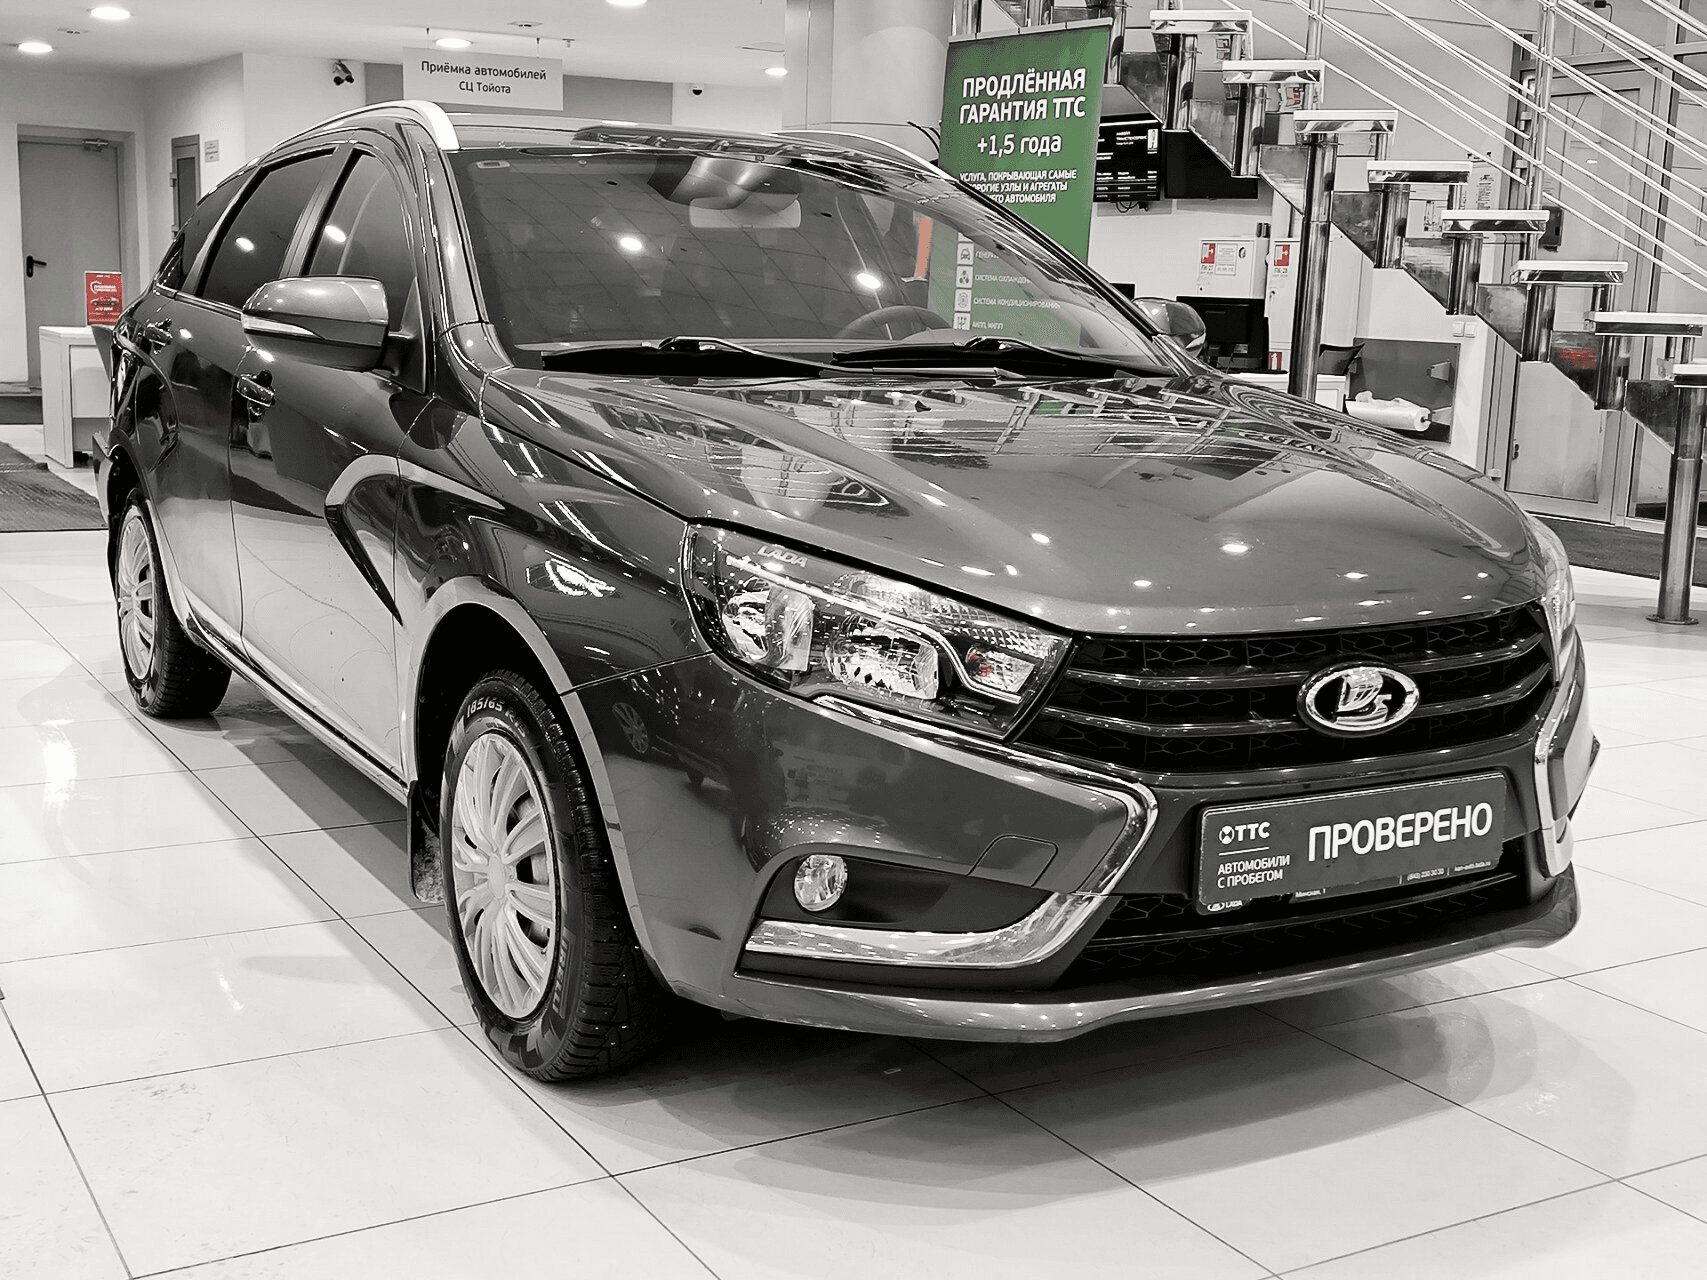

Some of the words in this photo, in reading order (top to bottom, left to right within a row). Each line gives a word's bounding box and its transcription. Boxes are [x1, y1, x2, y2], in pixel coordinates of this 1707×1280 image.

[421, 60, 471, 75] Приёмка
[474, 67, 547, 80] автомобилей
[459, 81, 473, 92] СЦ
[476, 82, 511, 94] Тойота
[962, 67, 1087, 99] ПРОДЛЁННАЯ
[959, 98, 1048, 124] ГАРАНТИЯ
[1052, 95, 1087, 119] ТТС
[977, 133, 1015, 158] +1,5
[1020, 134, 1062, 157] года
[960, 172, 987, 182] УСЛУГА,
[988, 170, 1047, 181] ПОКРЫВАЮЩАЯ
[1048, 169, 1077, 179] САМЫЕ
[970, 182, 999, 193] ОРОГИЕ
[1000, 182, 1022, 192] УЗЛЫ
[1022, 182, 1030, 191] И
[1030, 181, 1068, 191] АГРЕГАТЫ
[1005, 193, 1057, 203] АВТОМОБИЛЯ
[757, 545, 808, 568] LADA
[466, 696, 505, 718] 185/65
[1235, 821, 1271, 842] ТТС
[1308, 802, 1493, 862] ПРОВЕРЕНО
[1217, 854, 1291, 876] АВТОМОБИЛИ
[1217, 877, 1226, 889] С
[1226, 868, 1284, 887] ПРОБЕГОМ
